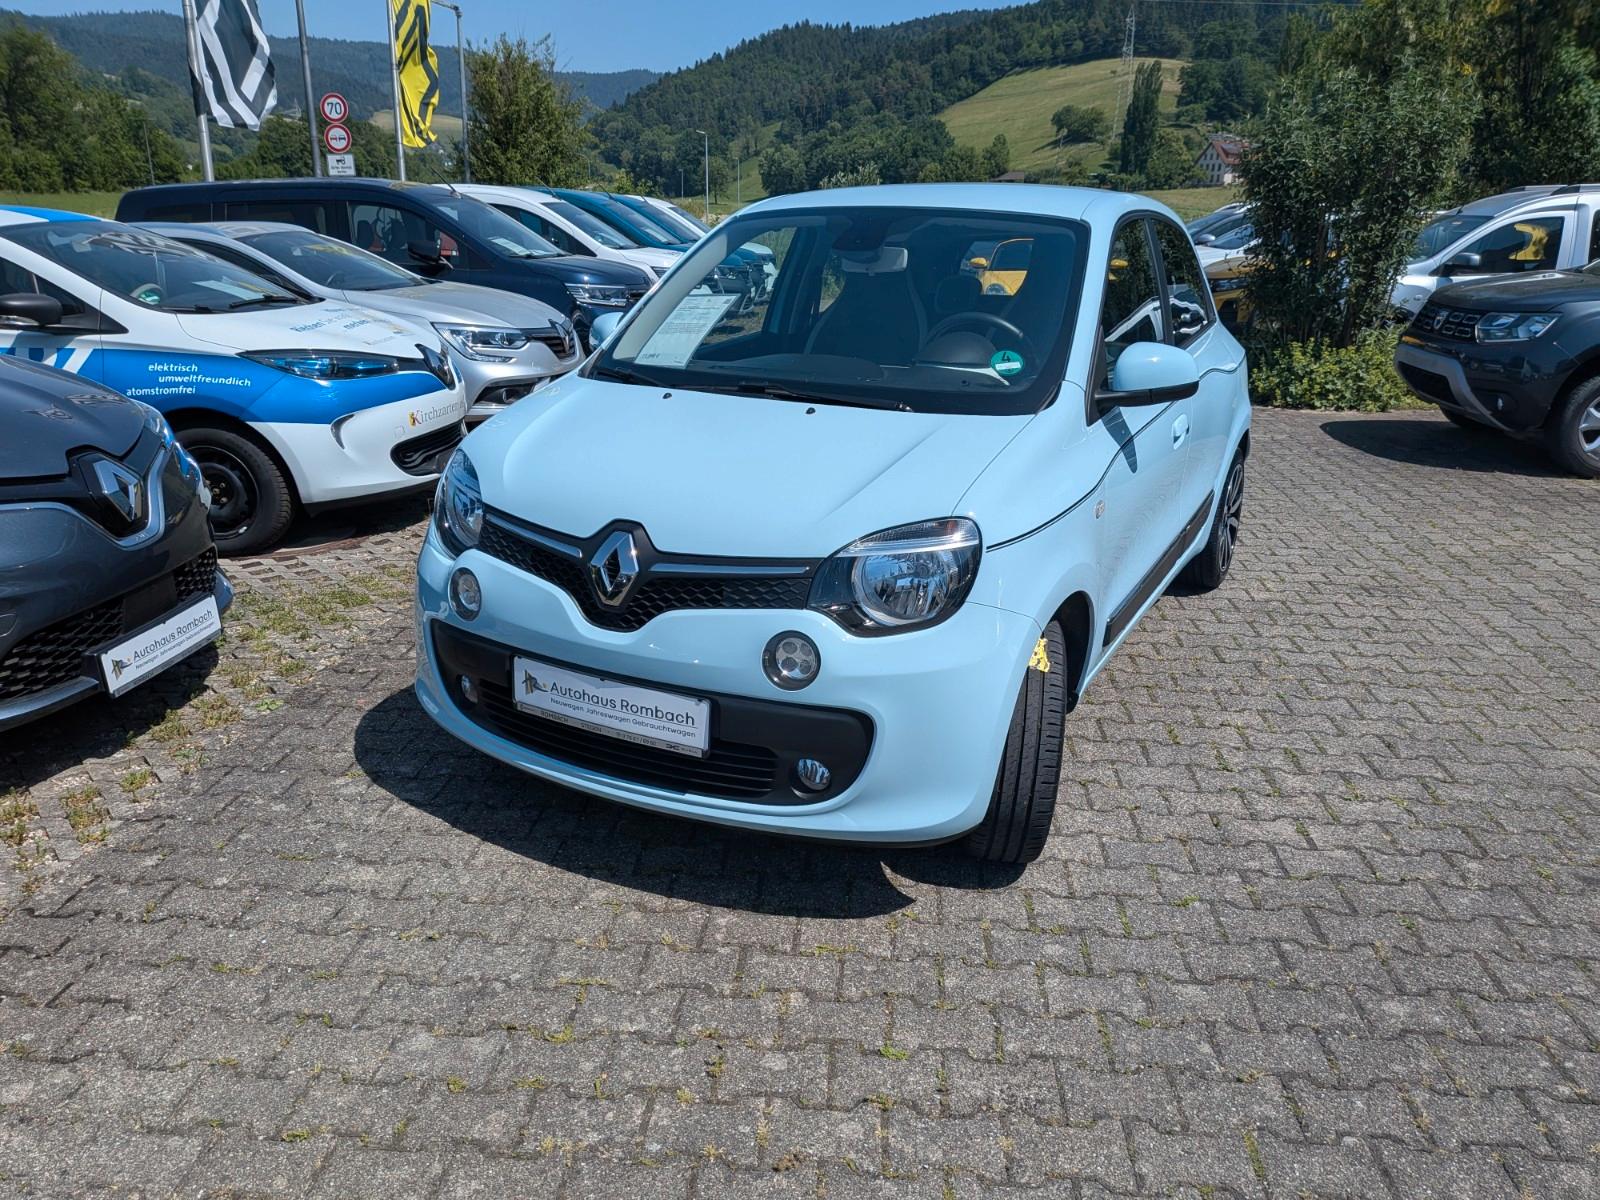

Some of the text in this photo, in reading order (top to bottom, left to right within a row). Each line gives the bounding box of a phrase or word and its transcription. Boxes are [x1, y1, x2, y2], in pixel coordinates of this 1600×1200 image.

[327, 102, 342, 115] 70
[1002, 352, 1011, 362] 4
[148, 363, 198, 372] elektrisch
[158, 374, 251, 387] umweltfreundlich
[126, 385, 196, 396] atomstromfrei
[133, 631, 176, 660] Autohaus
[176, 609, 213, 637] Rombach
[550, 681, 695, 726] Autohaus Rombach
[550, 697, 584, 712] Neuwagen
[586, 707, 631, 724] Jahreswagen
[632, 718, 696, 738] Gebrauchtwagen
